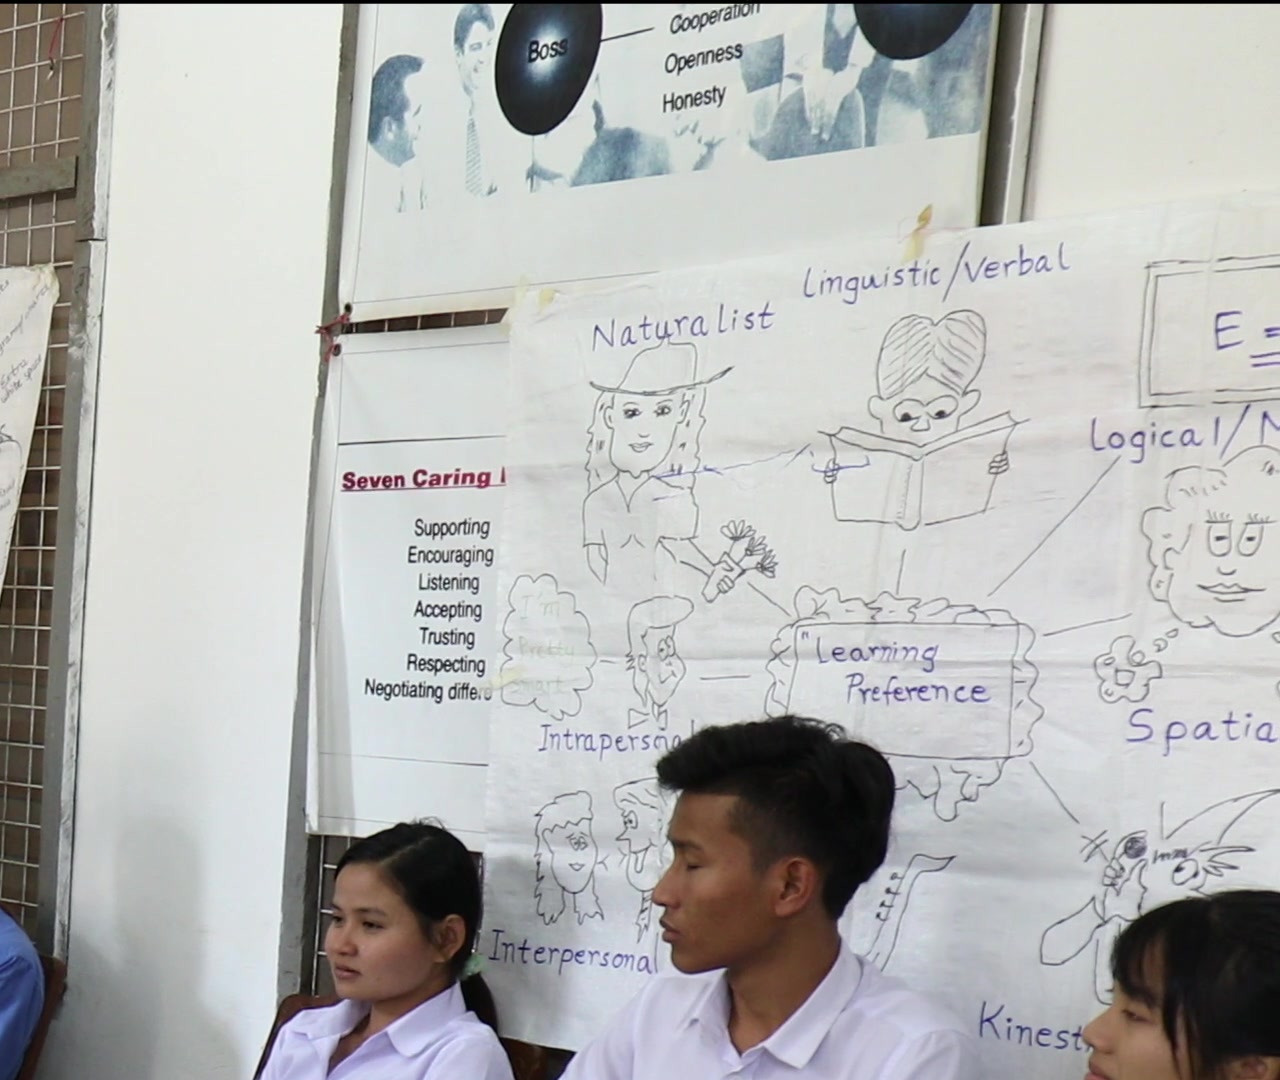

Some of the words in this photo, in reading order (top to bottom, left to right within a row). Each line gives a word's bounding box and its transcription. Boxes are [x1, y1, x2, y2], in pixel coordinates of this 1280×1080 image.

[669, 3, 761, 35] Cooperation
[526, 38, 569, 64] Boss
[663, 42, 744, 77] Openness
[661, 85, 728, 114] Honesty
[591, 301, 776, 352] Naturalist
[1214, 310, 1245, 351] E
[341, 471, 406, 490] Seven
[412, 467, 492, 489] Caring
[413, 517, 491, 541] Supporting
[406, 544, 495, 568] Encouraging
[417, 573, 480, 595] Listening
[413, 599, 483, 622] Accepting
[419, 626, 476, 650] Trusting
[406, 653, 486, 677] Respecting
[364, 678, 444, 704] Negotiating
[844, 672, 991, 706] Preference
[486, 929, 659, 976] Interpersonal
[978, 1000, 1090, 1053] Kinest
